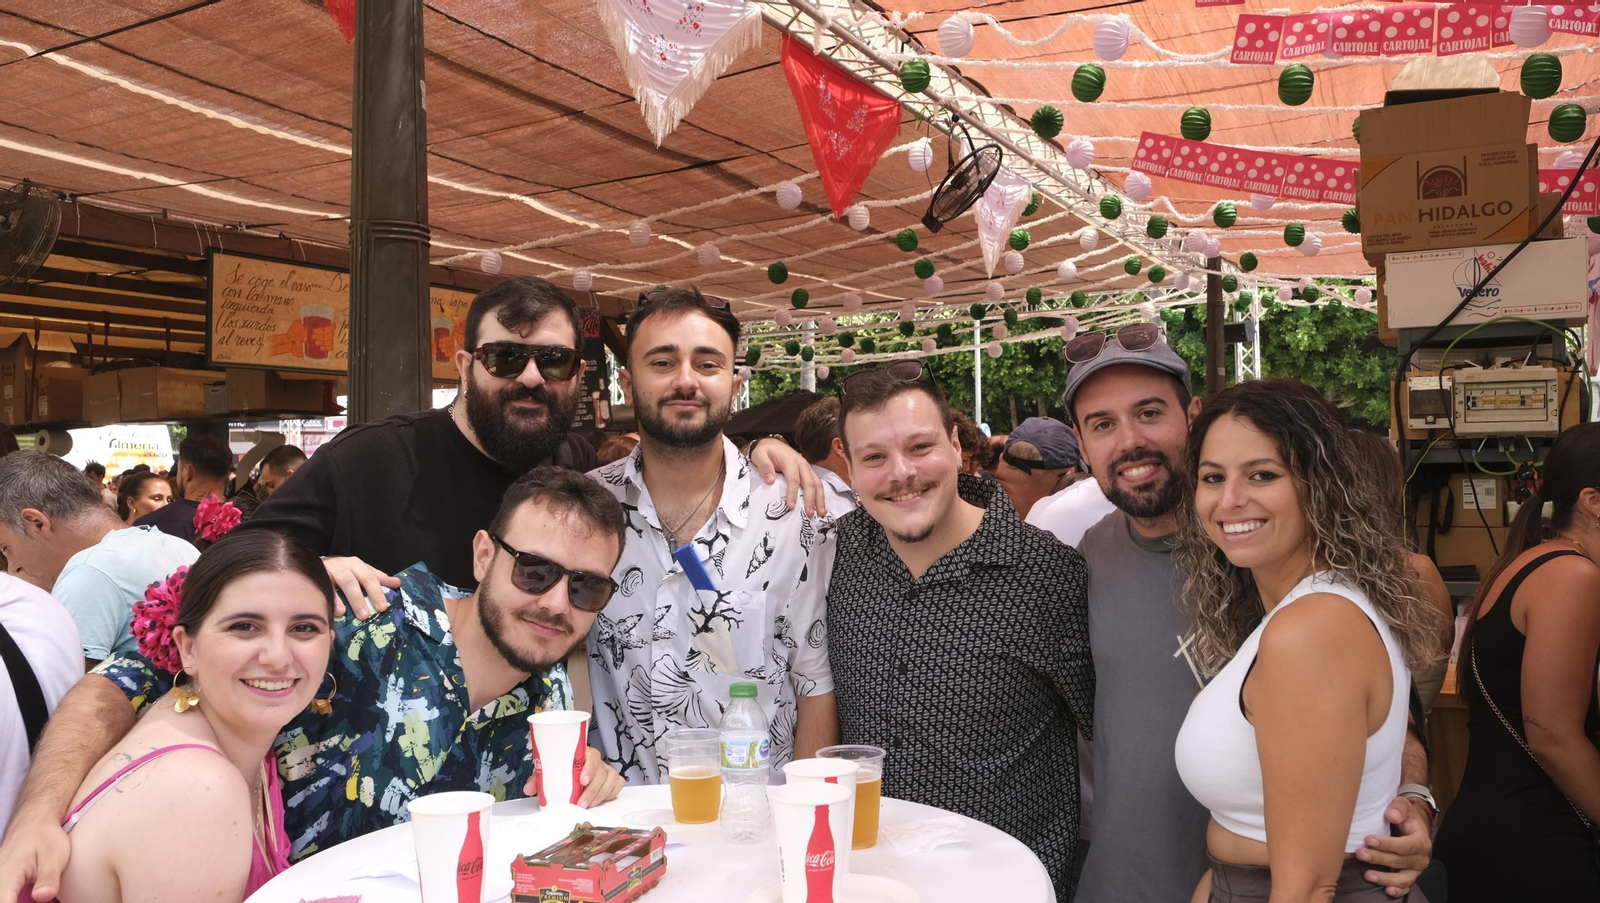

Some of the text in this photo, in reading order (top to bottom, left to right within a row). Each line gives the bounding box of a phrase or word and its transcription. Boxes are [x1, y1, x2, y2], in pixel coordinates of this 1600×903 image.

[1549, 18, 1598, 34] CARTOJAL
[1282, 40, 1326, 57] CARTOJAL
[1333, 42, 1379, 53] CARTOJAL
[1383, 39, 1430, 51] CARTOJAL
[1439, 37, 1489, 53] CARTOJAL
[1233, 50, 1275, 62] CARTOJAL
[1133, 159, 1166, 174] CARTOJAL
[1170, 168, 1202, 182] CARTOJAL
[1206, 174, 1240, 188] CARTOJAL
[1244, 180, 1279, 194] CARTOJAL
[1284, 186, 1320, 199] CARTOJAL
[1323, 190, 1356, 202] CARTOJA
[1374, 200, 1513, 227] PAN HIDALGO
[1561, 201, 1594, 212] RTOJAL
[226, 263, 244, 285] Se
[248, 276, 276, 297] coge
[280, 270, 296, 288] el
[222, 286, 294, 306] con la mano
[220, 298, 275, 315] izquierda
[240, 316, 276, 332] zurdos
[216, 330, 235, 346] al
